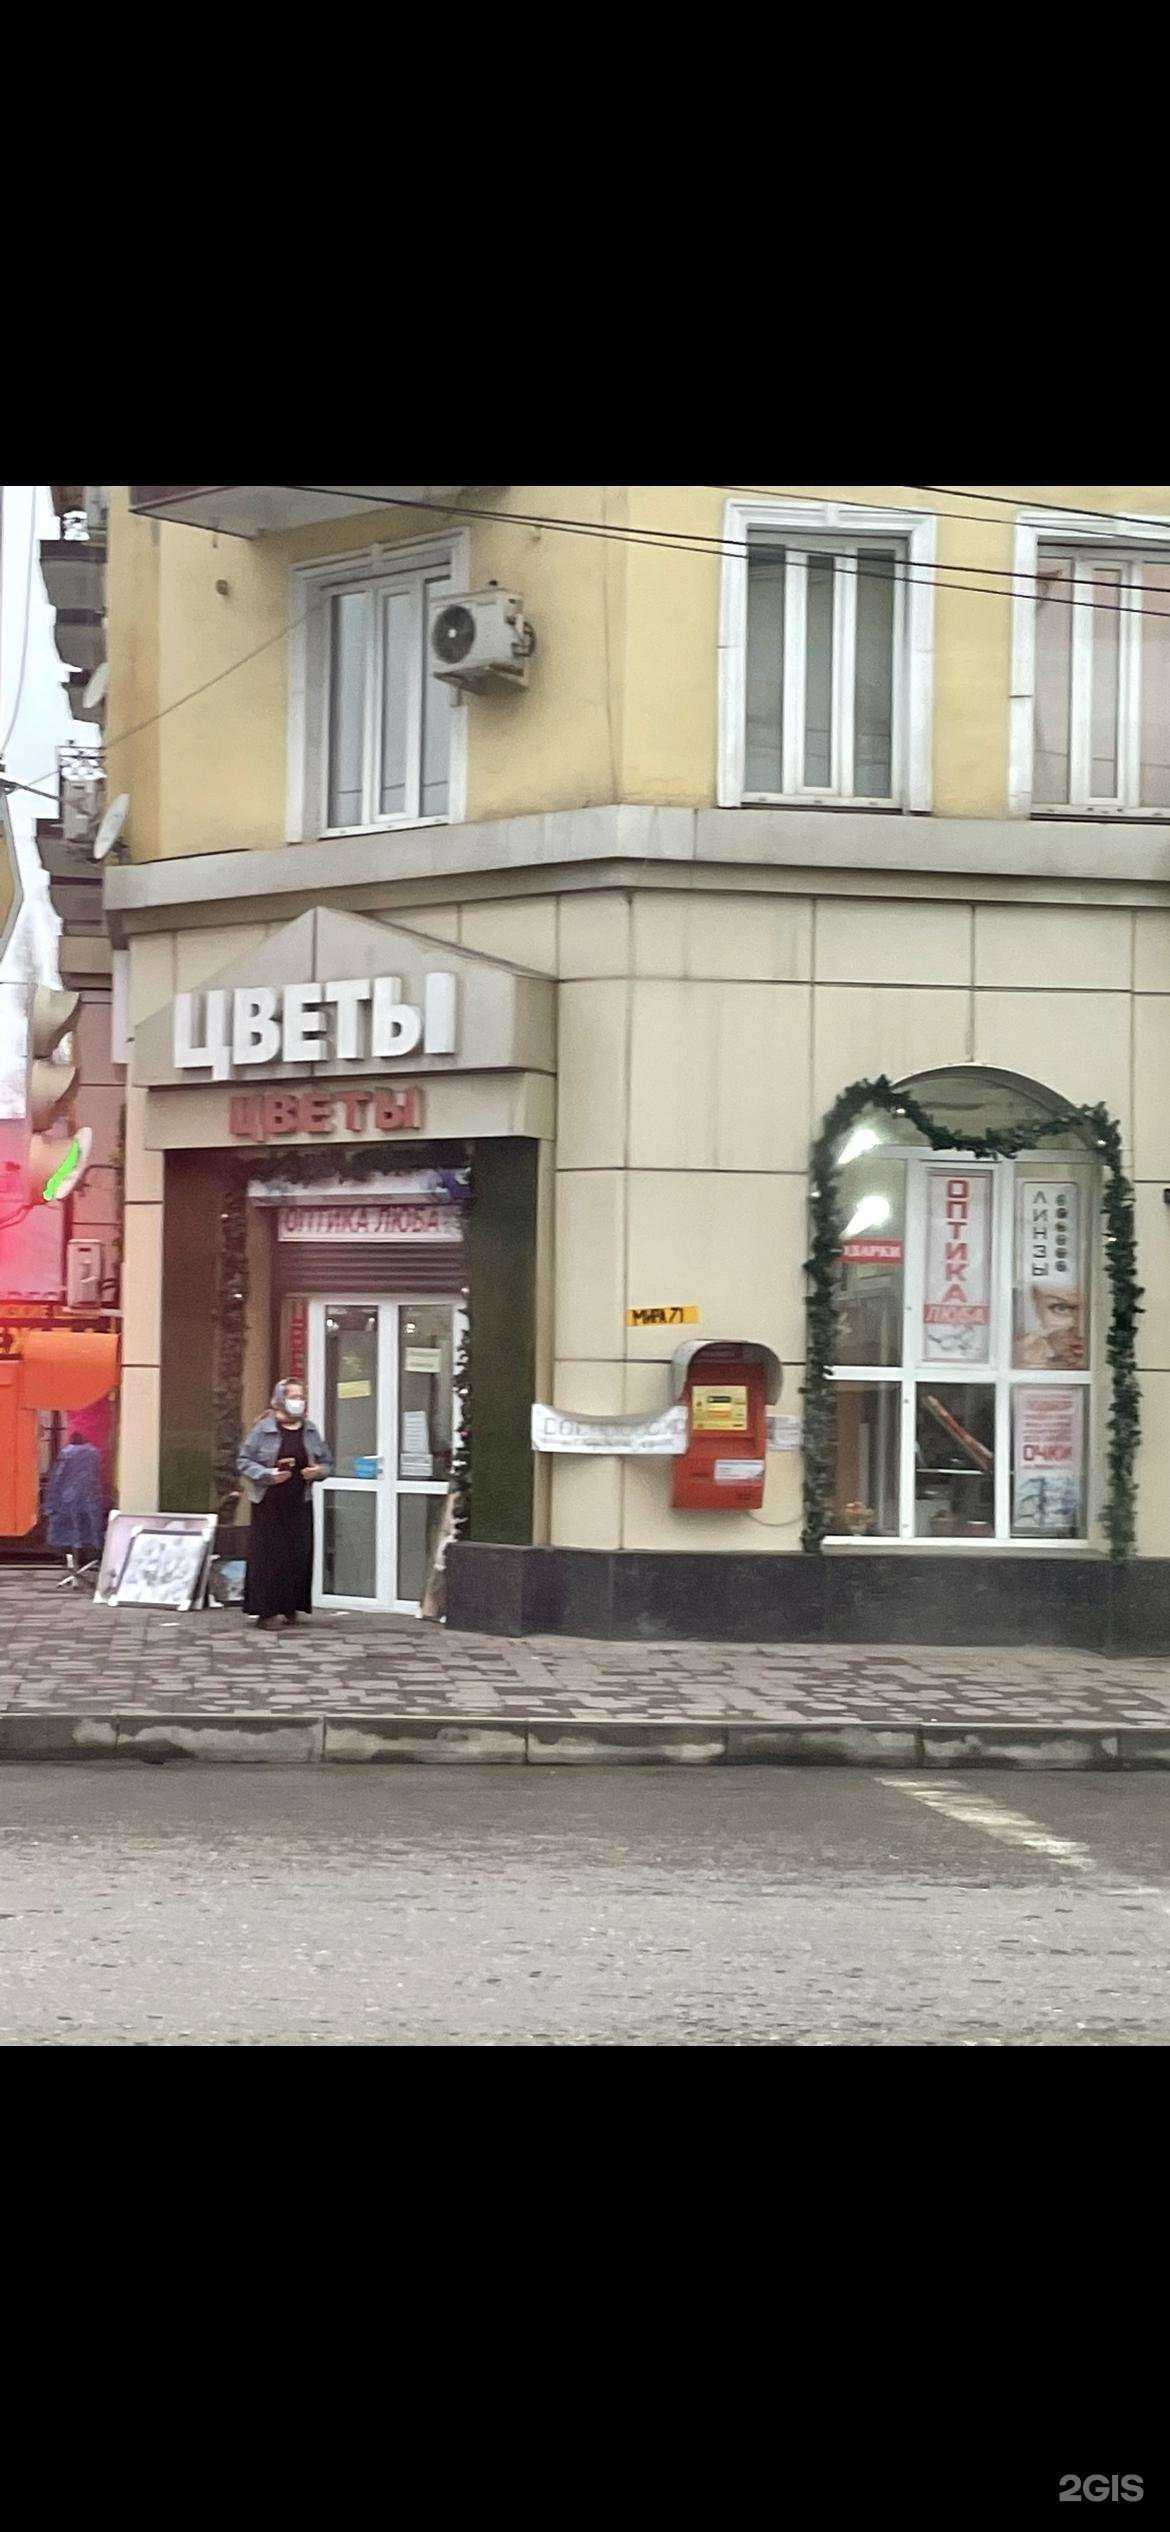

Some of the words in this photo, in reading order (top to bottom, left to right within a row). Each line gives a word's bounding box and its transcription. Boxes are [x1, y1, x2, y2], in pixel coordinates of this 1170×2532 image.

[174, 972, 456, 1080] ЦВЕТЫ
[229, 1087, 422, 1142] ЦВЕТЫ
[945, 1180, 969, 1302] ОПТИКА
